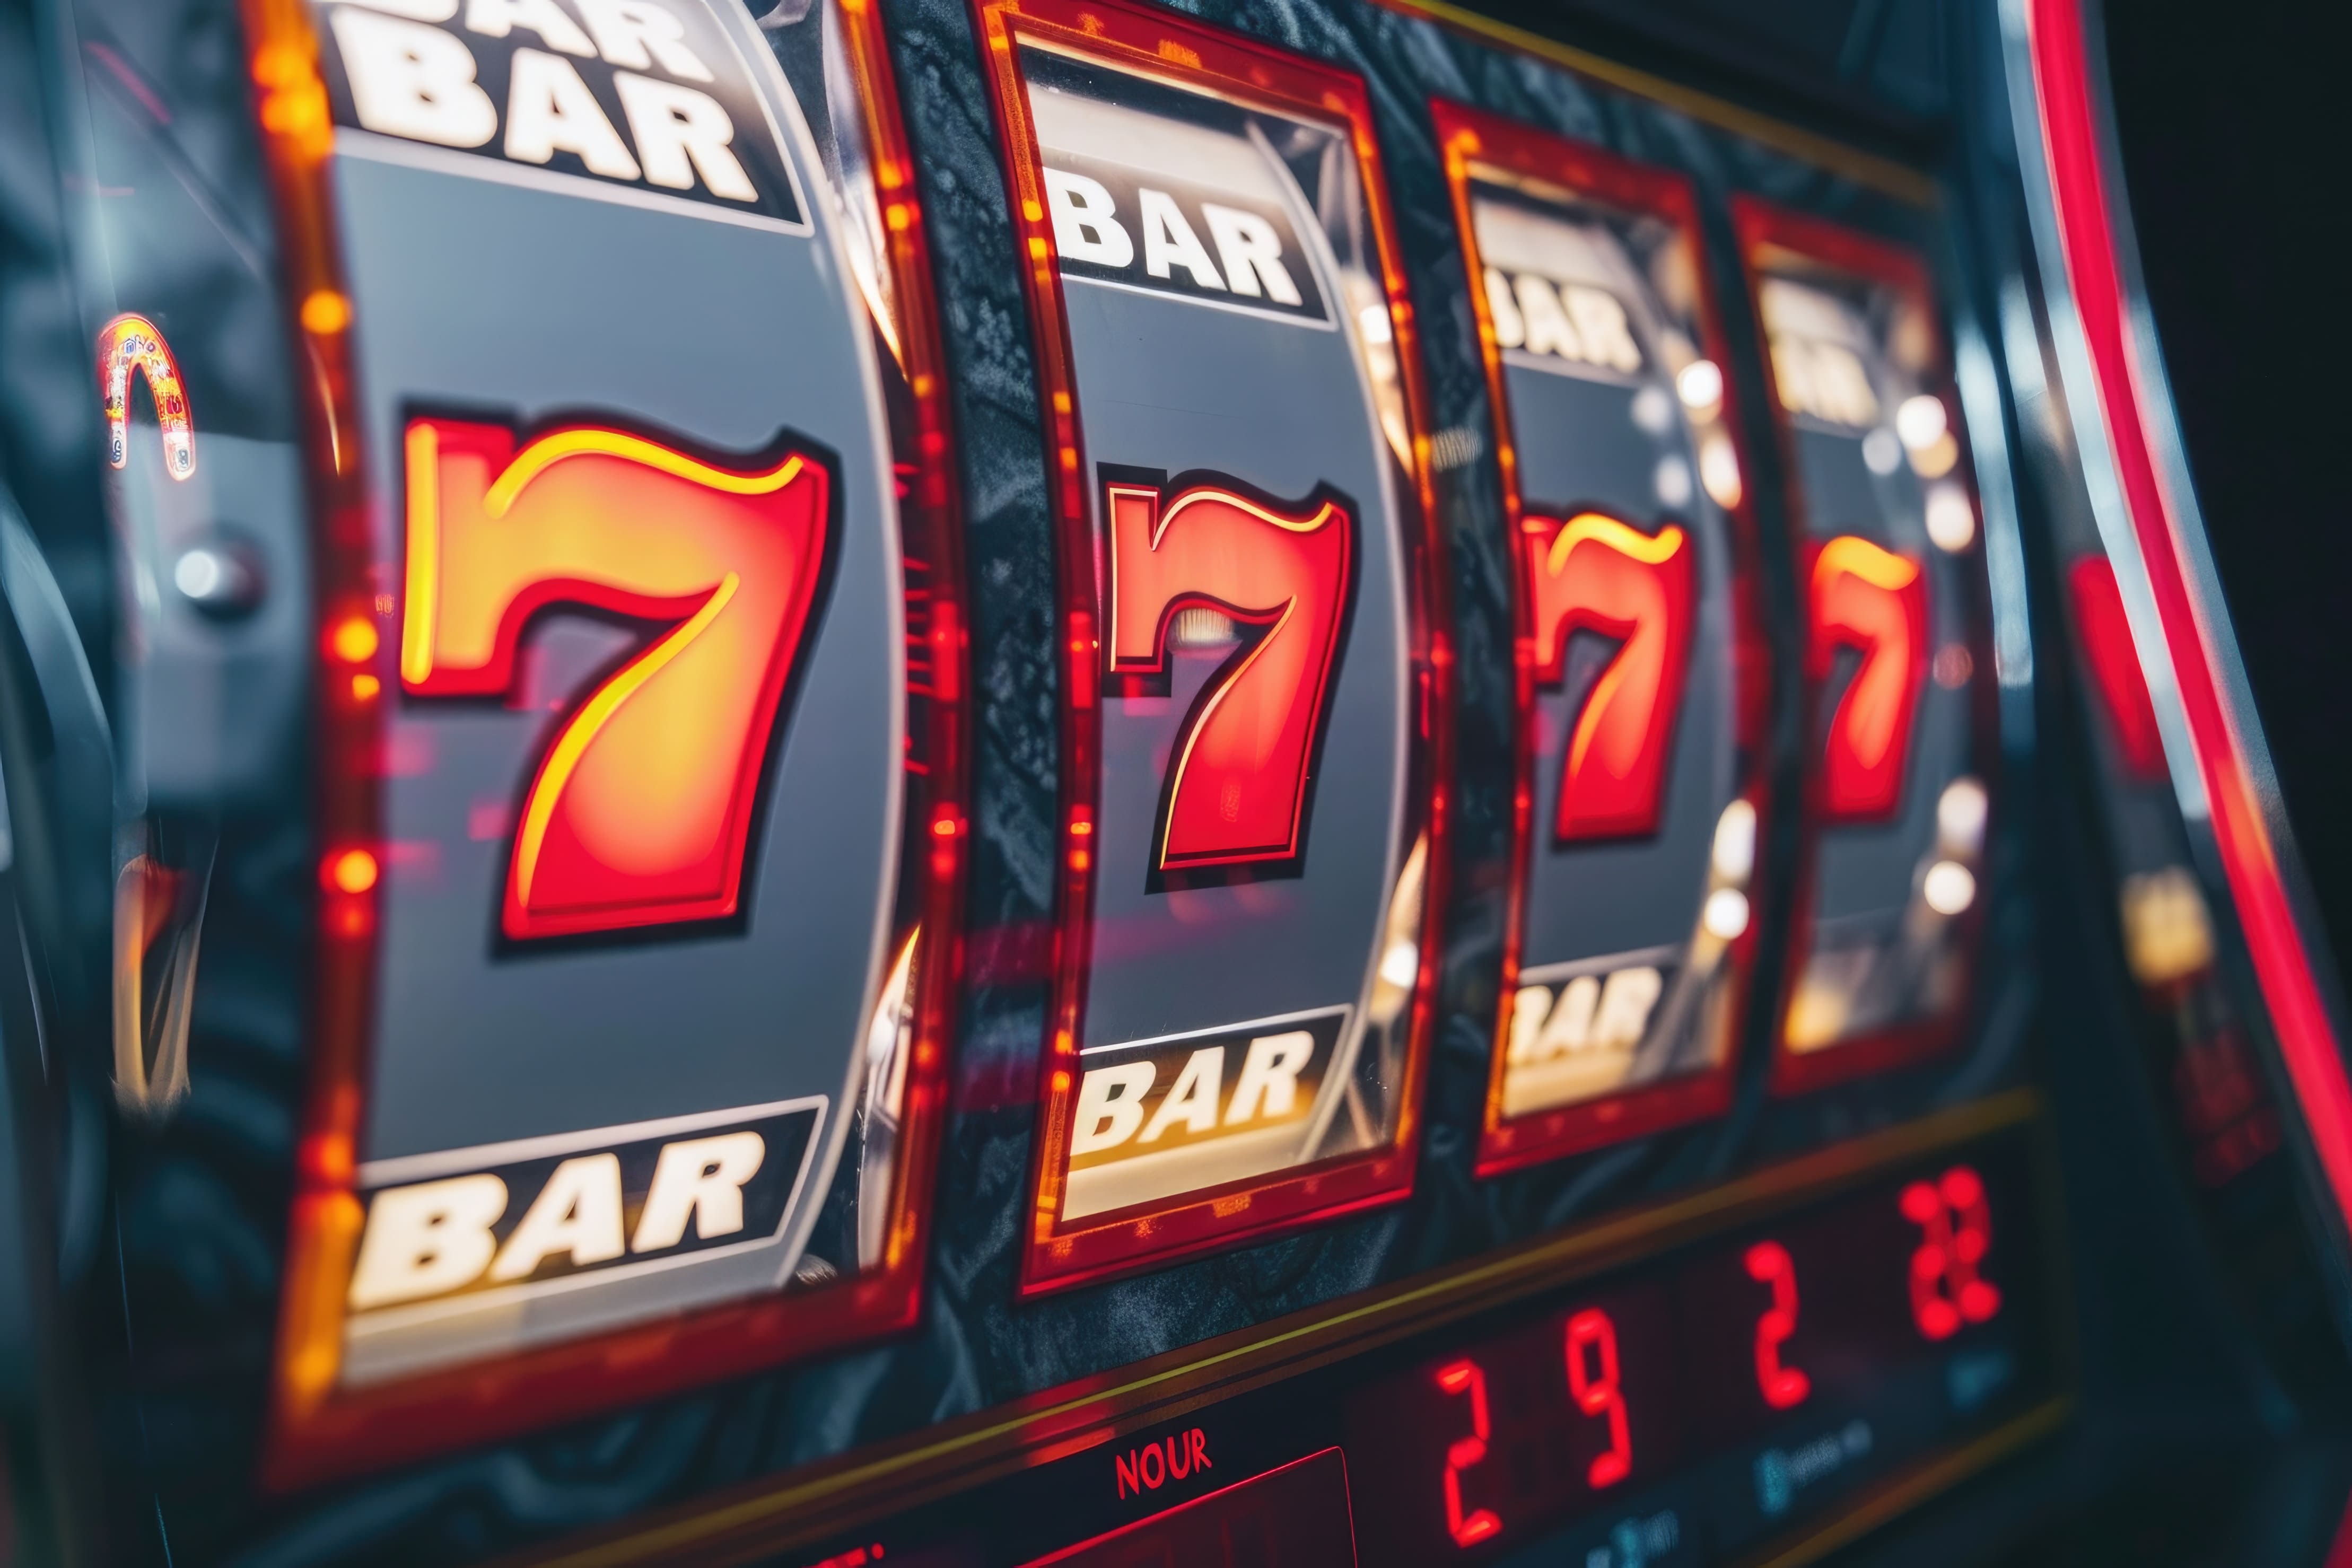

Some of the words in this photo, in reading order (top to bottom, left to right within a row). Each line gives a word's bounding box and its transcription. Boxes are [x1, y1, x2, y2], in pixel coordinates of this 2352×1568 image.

[330, 5, 758, 202] BAR
[347, 0, 715, 83] AR
[1043, 167, 1303, 306] BAR
[401, 416, 828, 940] 7
[1106, 482, 1351, 871] 7
[1521, 512, 1693, 842] 7
[1807, 536, 1930, 822] 7
[1070, 1031, 1314, 1157] BAR
[347, 1131, 765, 1310] BAR
[1115, 1428, 1212, 1500] NOUR
